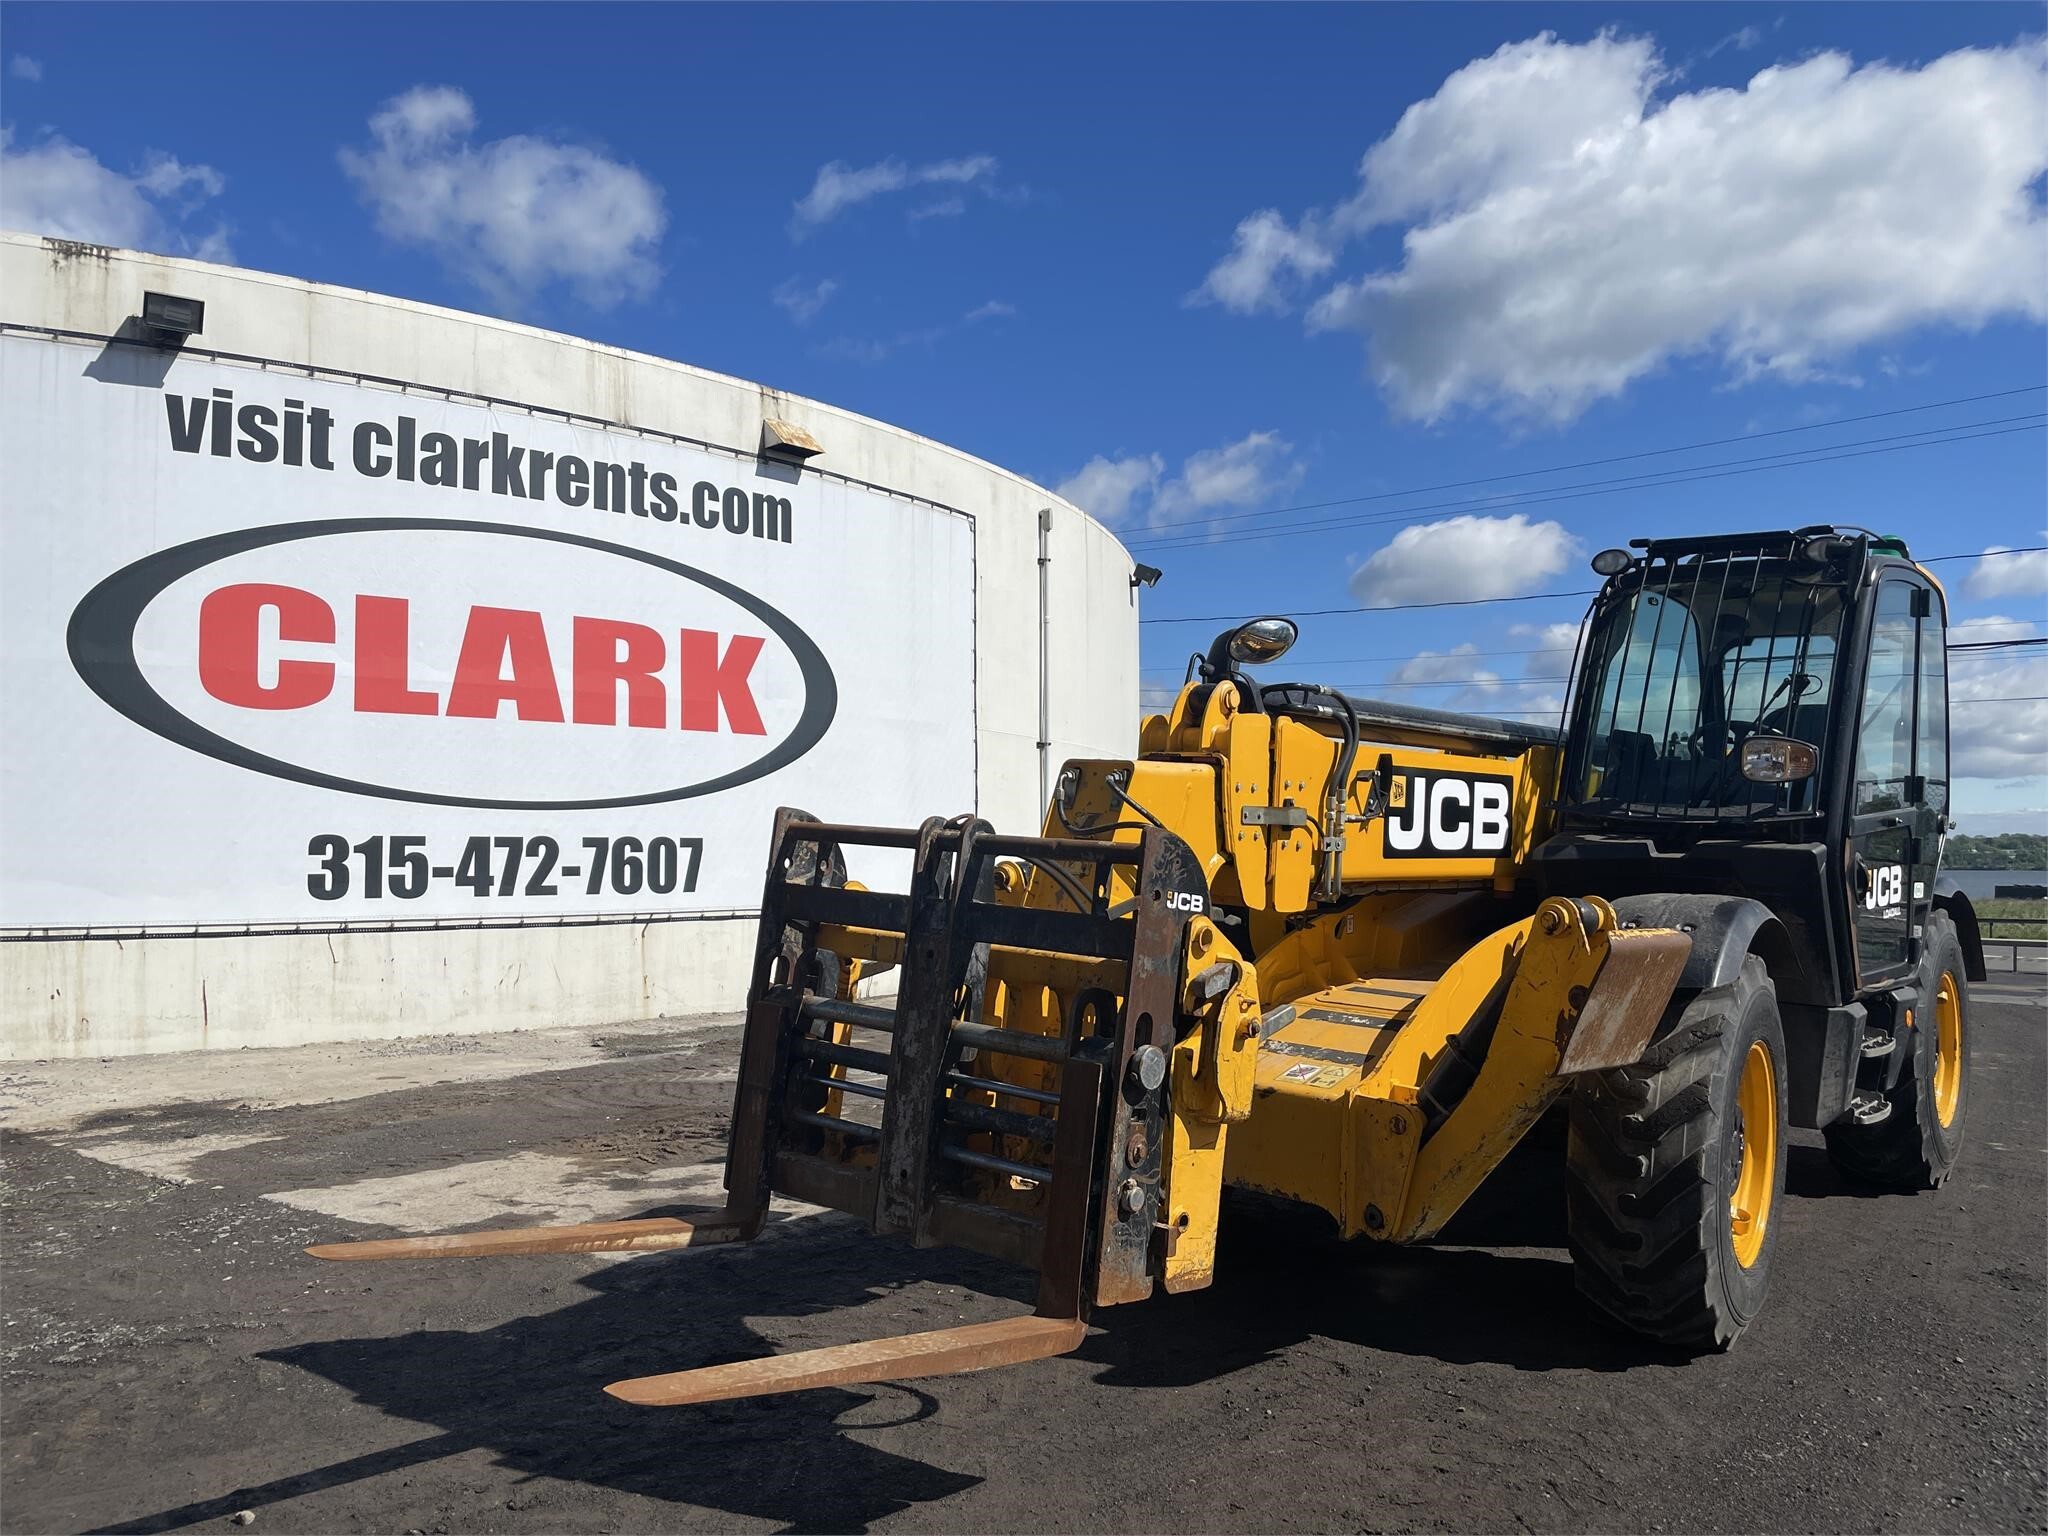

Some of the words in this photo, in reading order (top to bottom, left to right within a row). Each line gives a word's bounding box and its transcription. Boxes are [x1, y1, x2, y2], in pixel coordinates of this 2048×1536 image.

[165, 388, 334, 470] visit
[352, 416, 793, 543] clarkrents.com
[199, 583, 767, 735] CLARK
[1389, 777, 1509, 850] JCB
[307, 835, 704, 900] 315-472-7607
[1167, 891, 1204, 912] JCB
[1866, 866, 1902, 909] JCB
